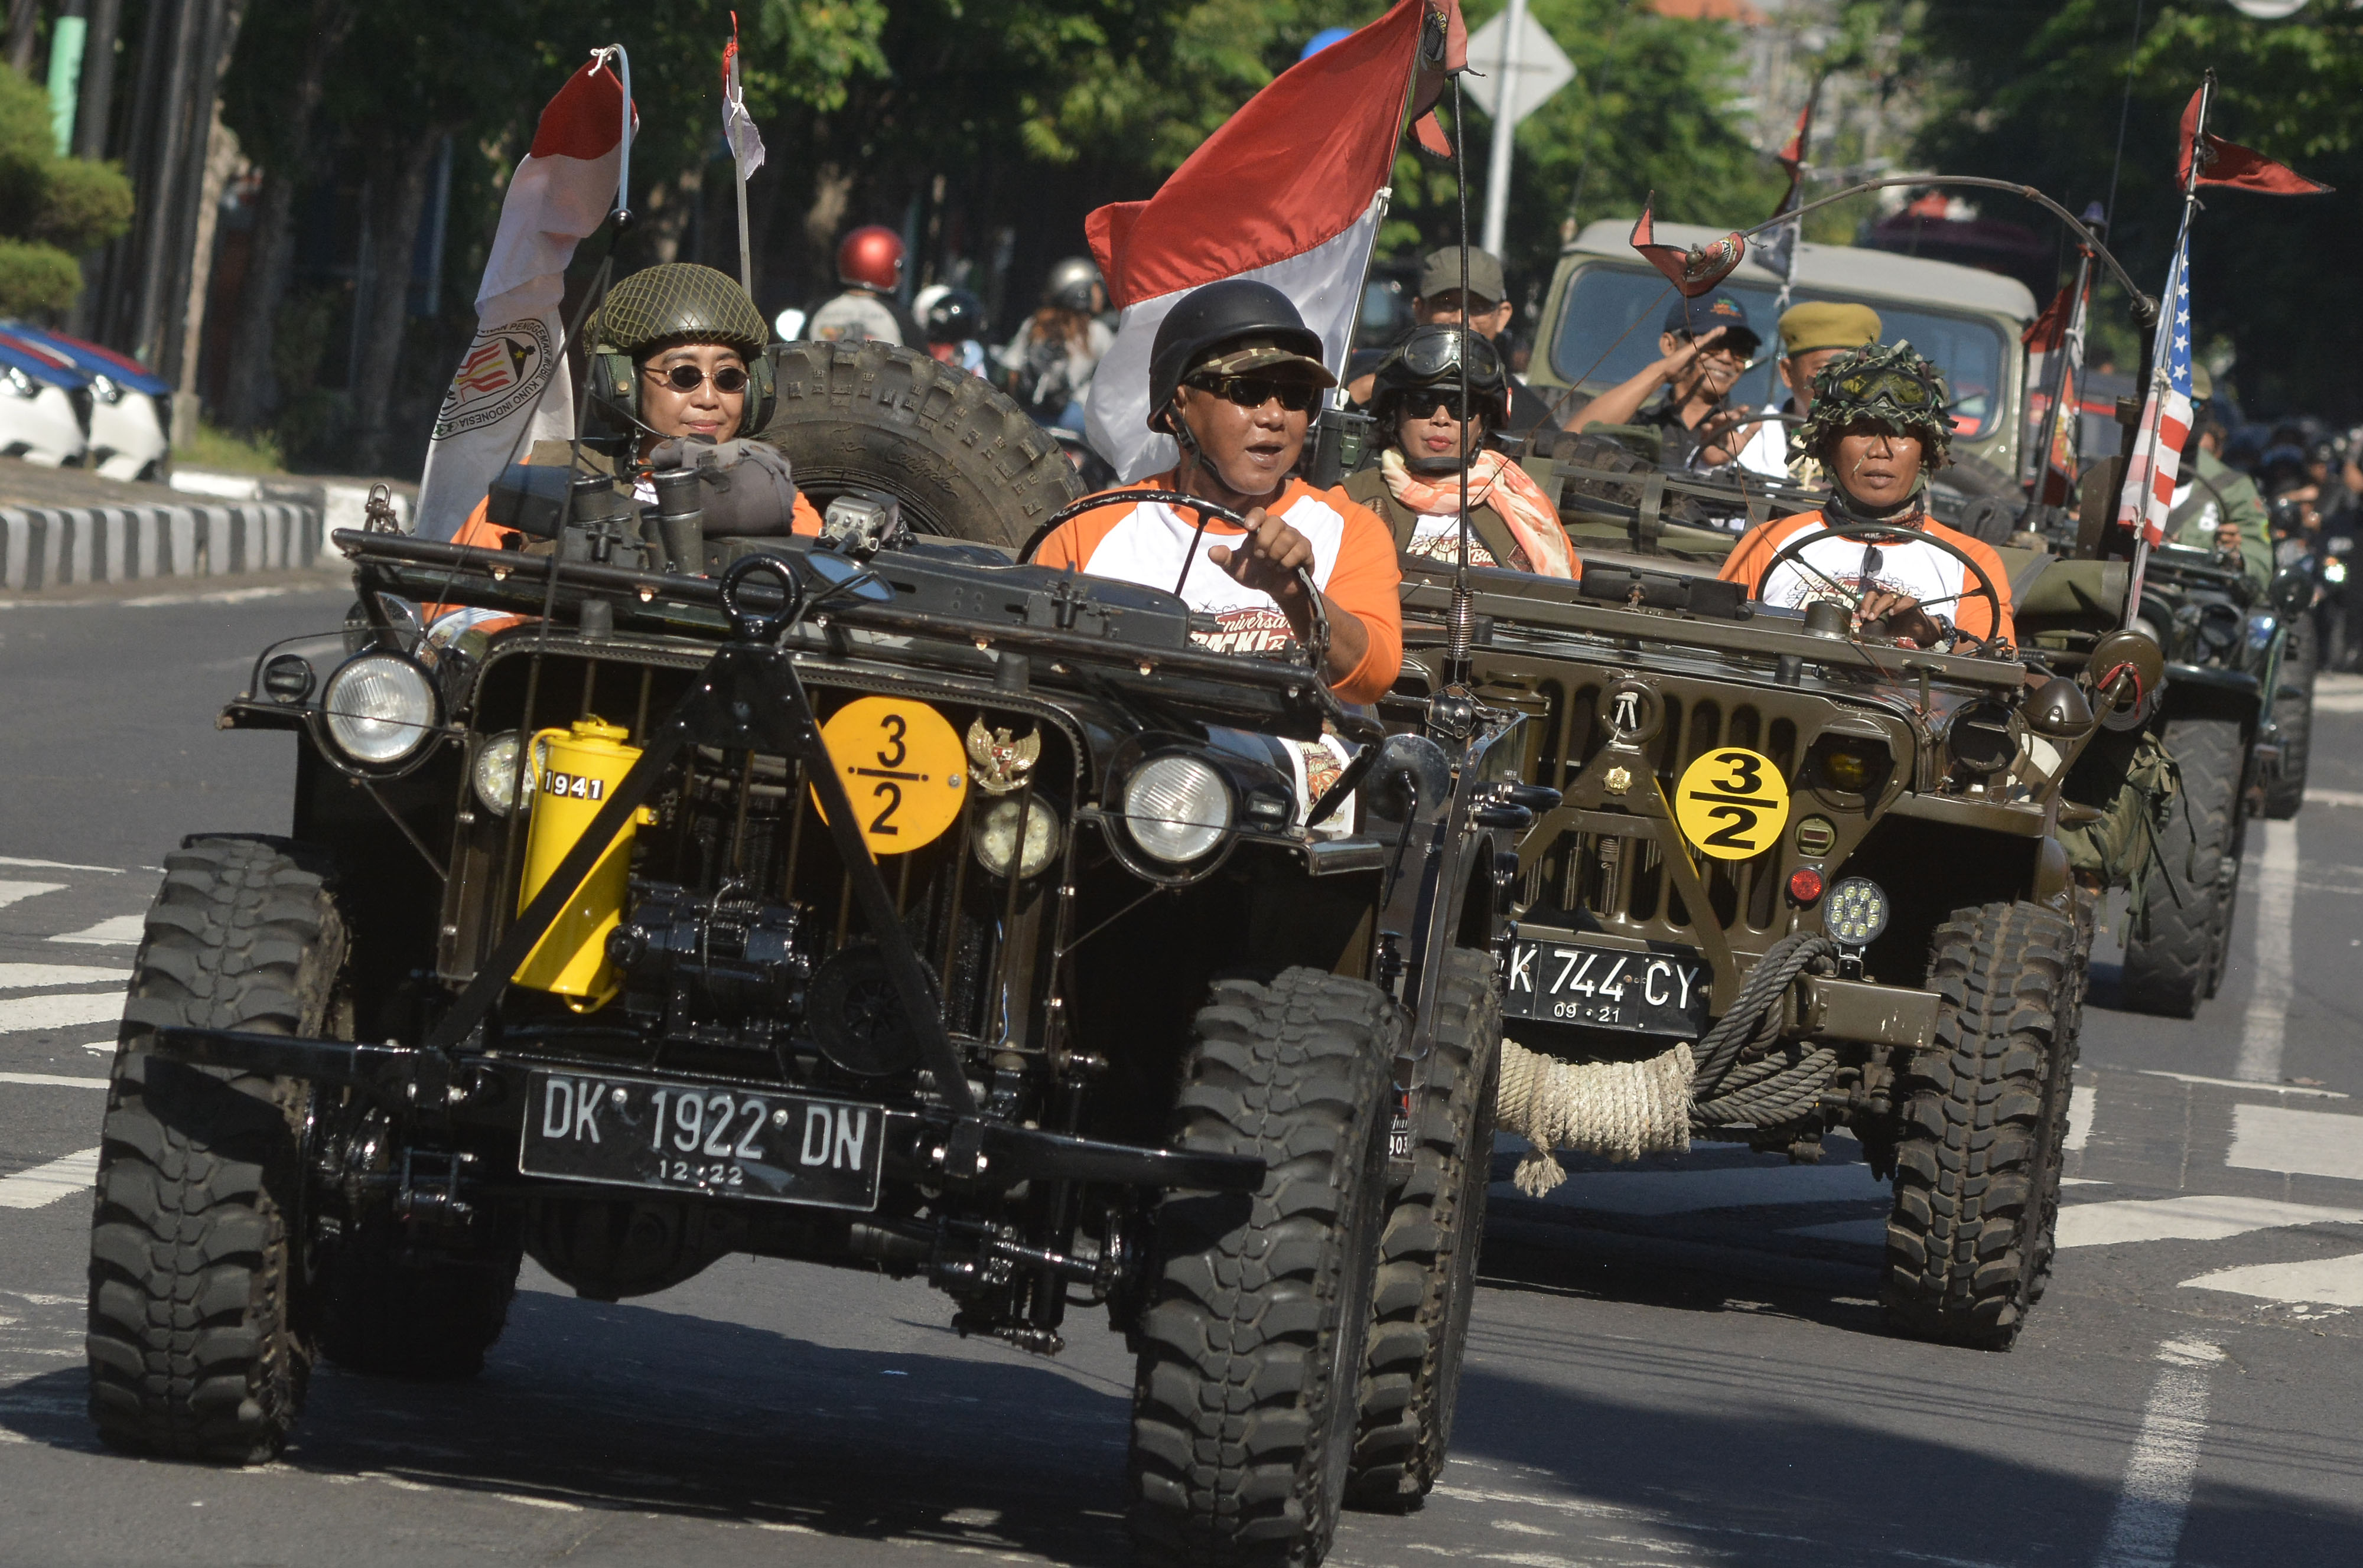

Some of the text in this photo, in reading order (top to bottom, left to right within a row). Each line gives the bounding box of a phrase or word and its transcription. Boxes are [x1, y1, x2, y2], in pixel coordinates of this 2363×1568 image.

[460, 401, 513, 427] INDONESIA
[513, 380, 539, 404] KUNO
[877, 715, 906, 768] 3
[546, 771, 601, 799] 1941
[1711, 753, 1762, 794] 3
[869, 781, 901, 836] 2
[1703, 806, 1758, 850] 2
[1510, 946, 1699, 1009] K 744 CY
[543, 1079, 867, 1171] DK 1922 DN
